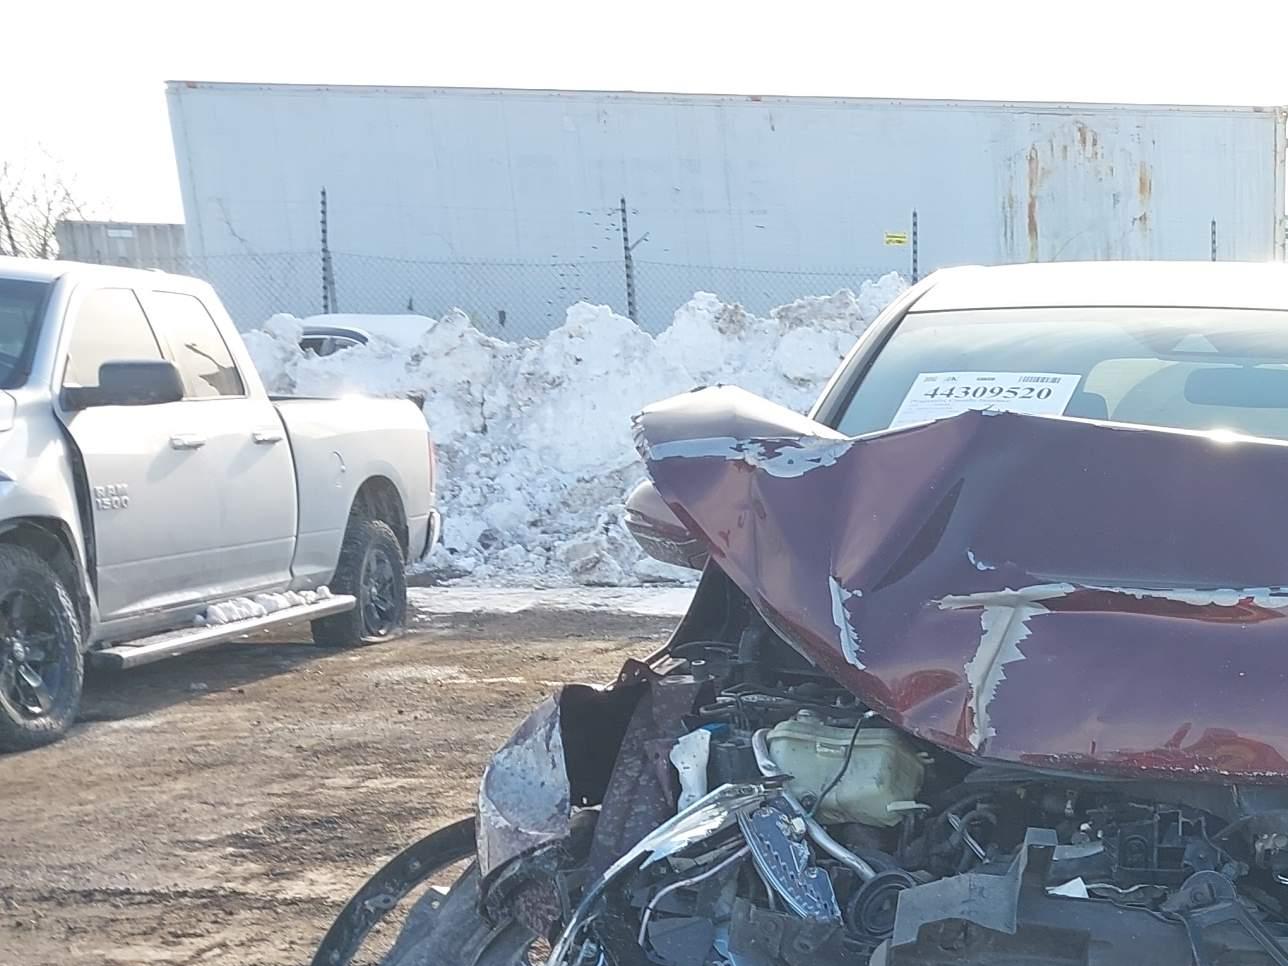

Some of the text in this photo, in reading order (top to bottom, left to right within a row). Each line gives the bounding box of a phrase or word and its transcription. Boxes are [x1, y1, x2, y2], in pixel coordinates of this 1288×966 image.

[923, 385, 1053, 400] 44309520
[94, 482, 128, 498] RAM
[95, 495, 129, 511] 1500
